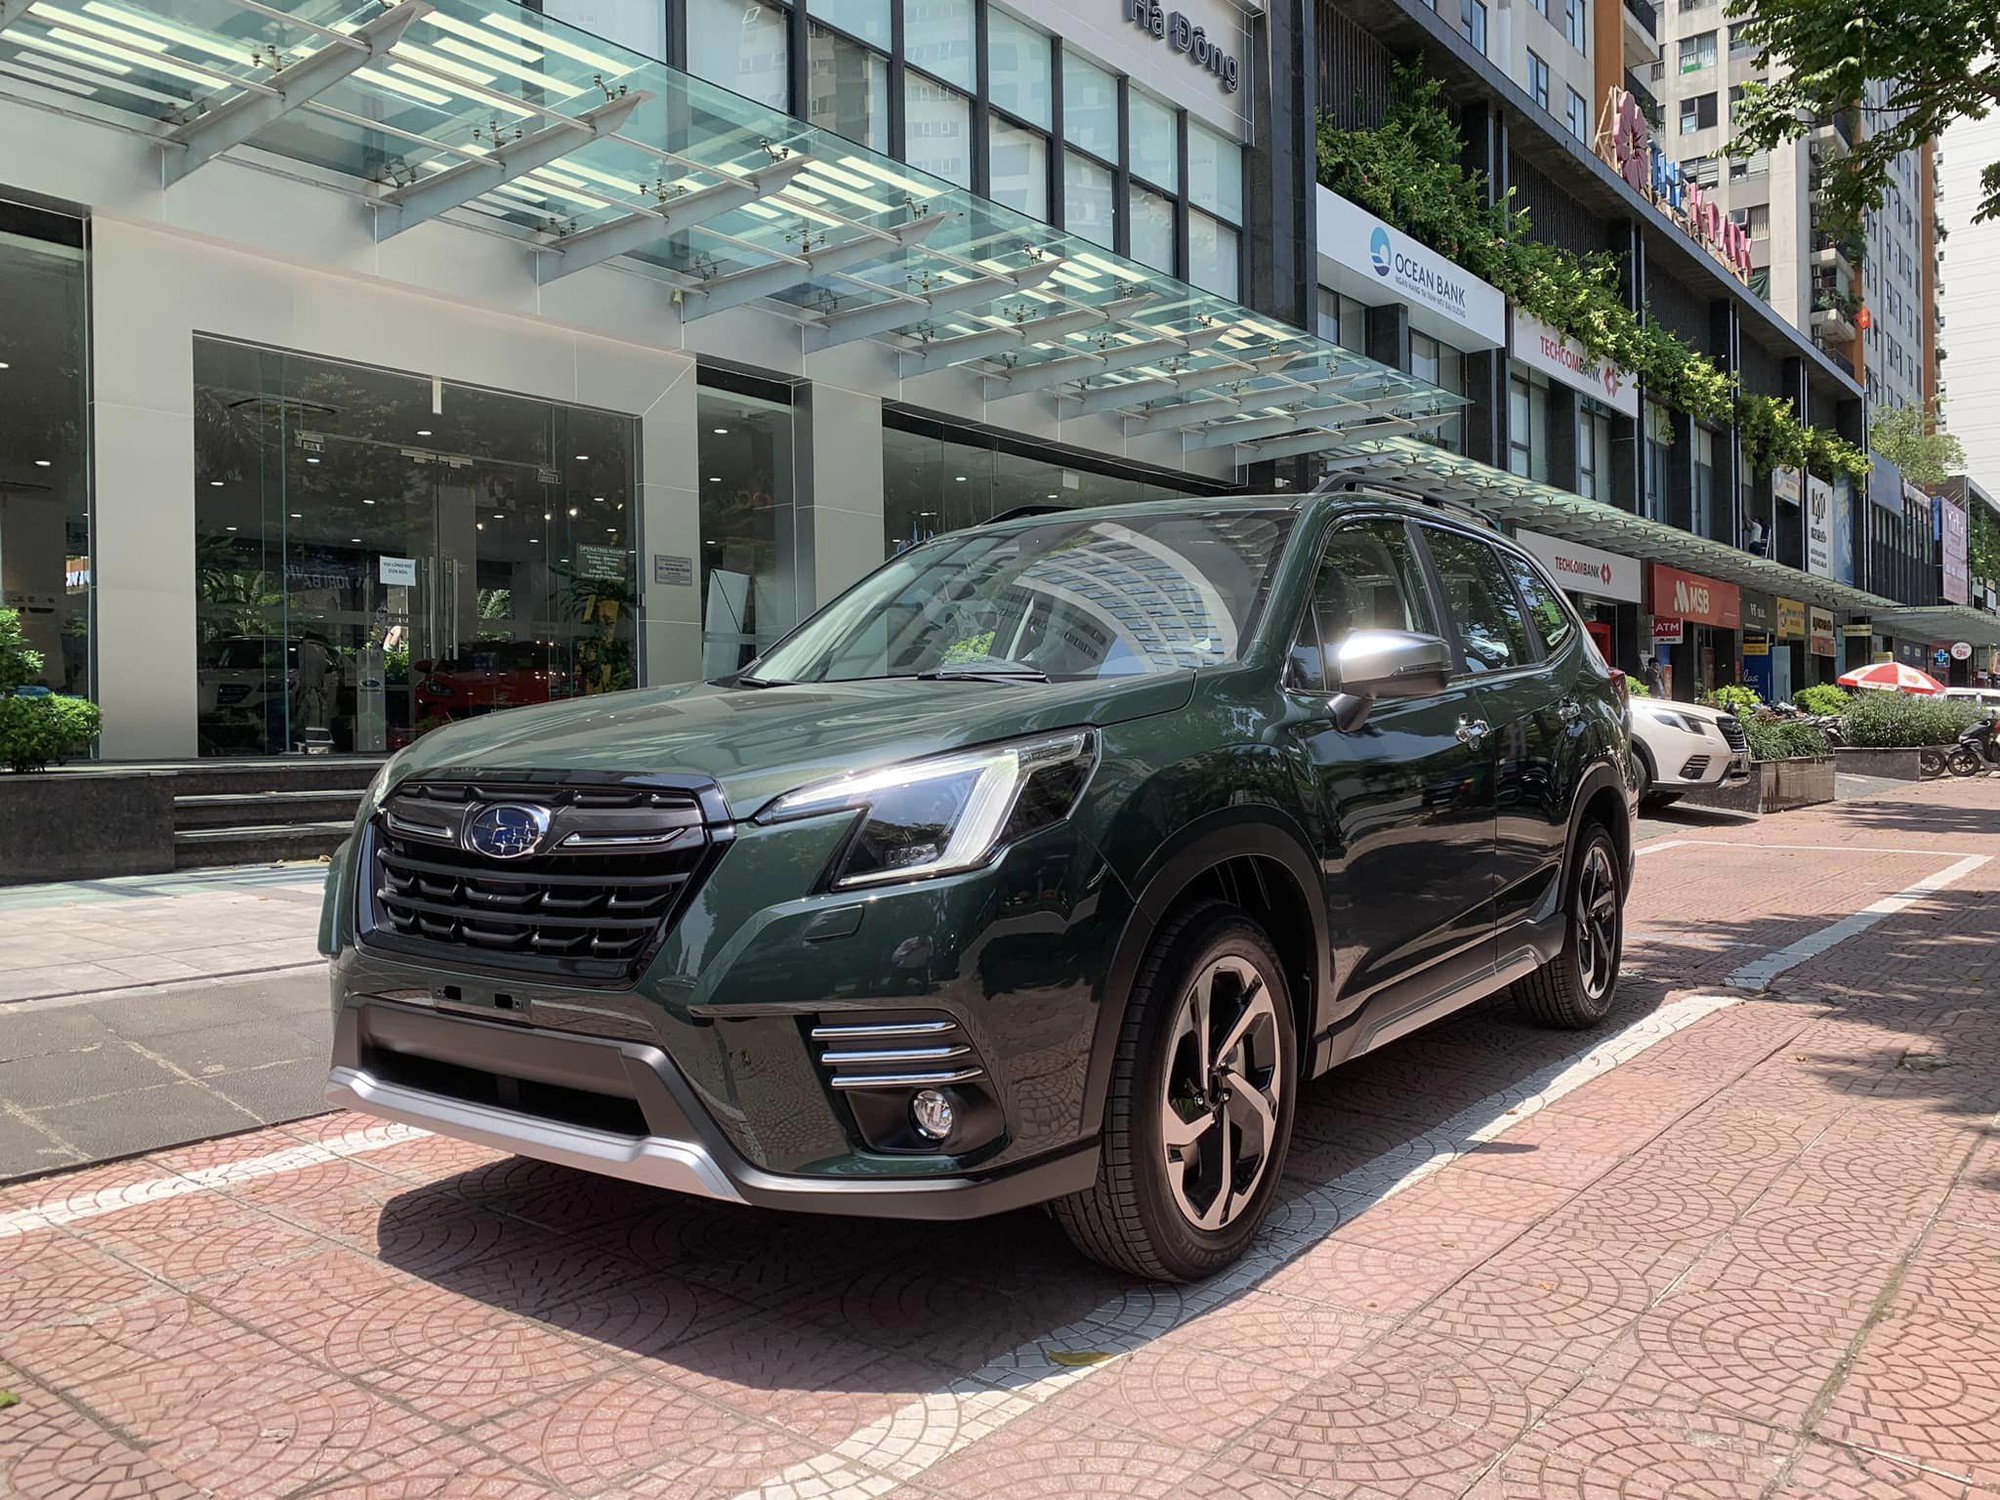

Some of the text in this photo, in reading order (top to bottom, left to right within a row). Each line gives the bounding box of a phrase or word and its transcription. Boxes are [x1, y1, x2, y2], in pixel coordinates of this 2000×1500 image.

[1168, 11, 1239, 93] Đông
[1395, 253, 1466, 308] OCEAN BANK
[1555, 556, 1600, 579] TECHCOMBANK
[1689, 586, 1710, 615] MSB
[1655, 622, 1680, 633] ATM
